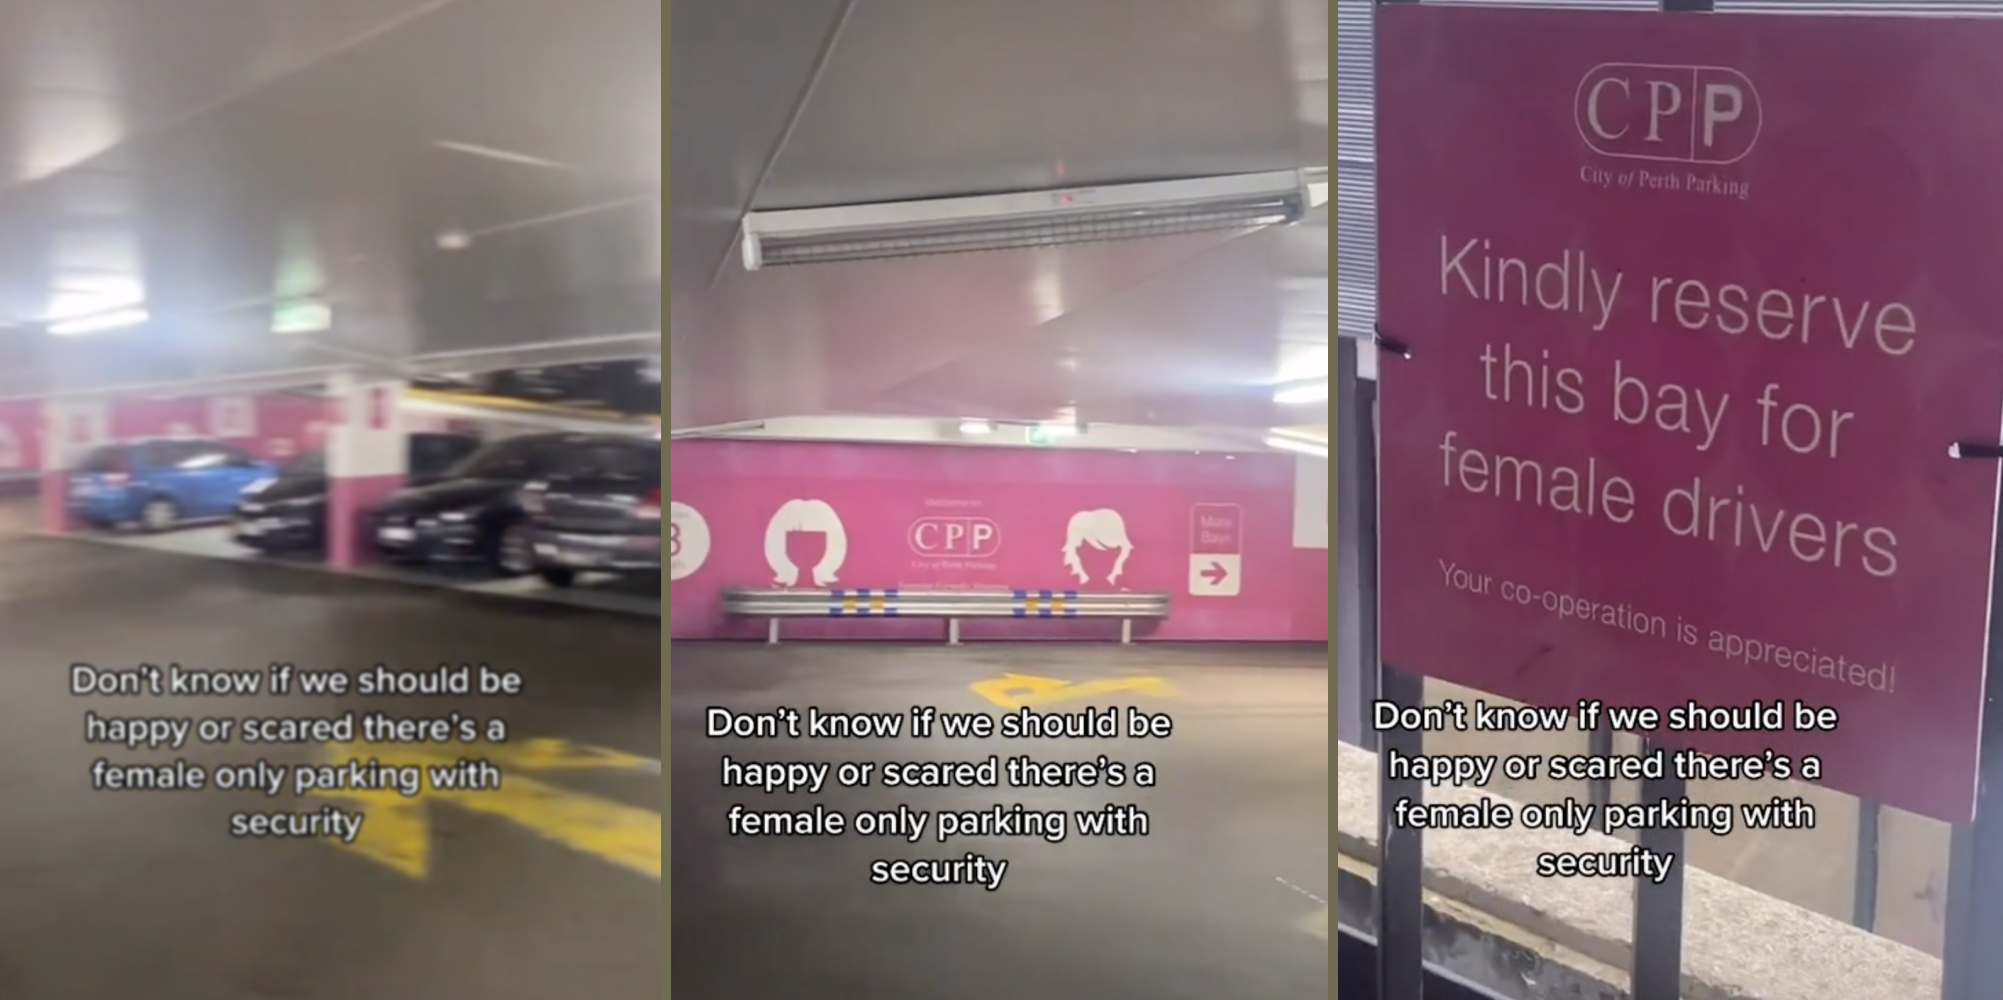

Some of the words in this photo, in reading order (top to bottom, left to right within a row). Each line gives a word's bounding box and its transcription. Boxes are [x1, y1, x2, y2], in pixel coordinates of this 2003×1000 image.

[1586, 77, 1744, 147] CPP
[1580, 165, 1612, 188] City
[1617, 171, 1634, 188] of
[1639, 170, 1681, 190] Perth
[1687, 173, 1750, 200] Parking
[1440, 234, 1623, 332] Kindly
[1651, 275, 1917, 354] reserve
[1480, 343, 1586, 414] this
[1613, 360, 1730, 450] bay
[1757, 383, 1854, 458] for
[914, 522, 994, 551] CPP
[1439, 430, 1637, 524] female
[1663, 477, 1899, 577] drivers
[1438, 558, 1493, 596] Your
[1500, 580, 1667, 638] co-operation
[1677, 616, 1699, 645] is
[1708, 627, 1897, 694] appreciated!
